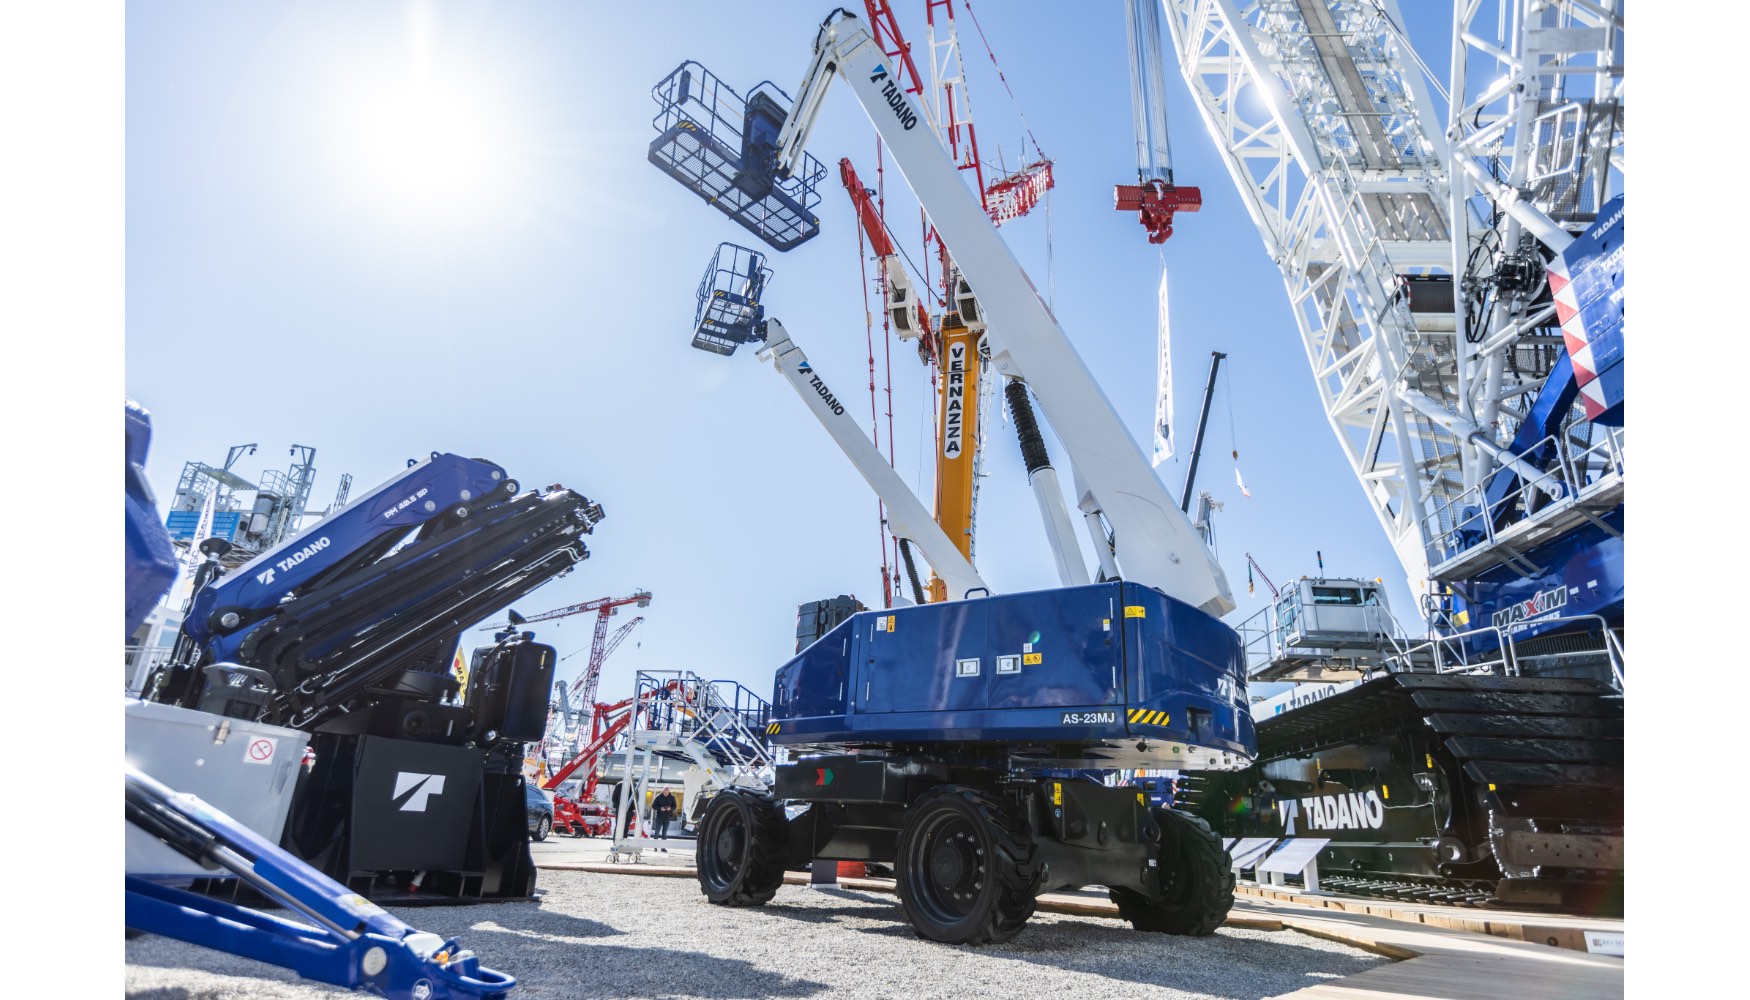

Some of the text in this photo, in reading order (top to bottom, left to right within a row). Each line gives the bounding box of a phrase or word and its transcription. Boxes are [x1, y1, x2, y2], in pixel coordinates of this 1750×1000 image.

[881, 79, 917, 131] TADANO
[810, 374, 844, 416] TADANO
[946, 347, 964, 453] VERNAZZA
[384, 507, 398, 519] PM
[276, 536, 331, 572] TADANO
[1492, 585, 1567, 629] MAXIM
[1063, 712, 1115, 725] AS-23MJ
[1301, 790, 1383, 830] TADANO
